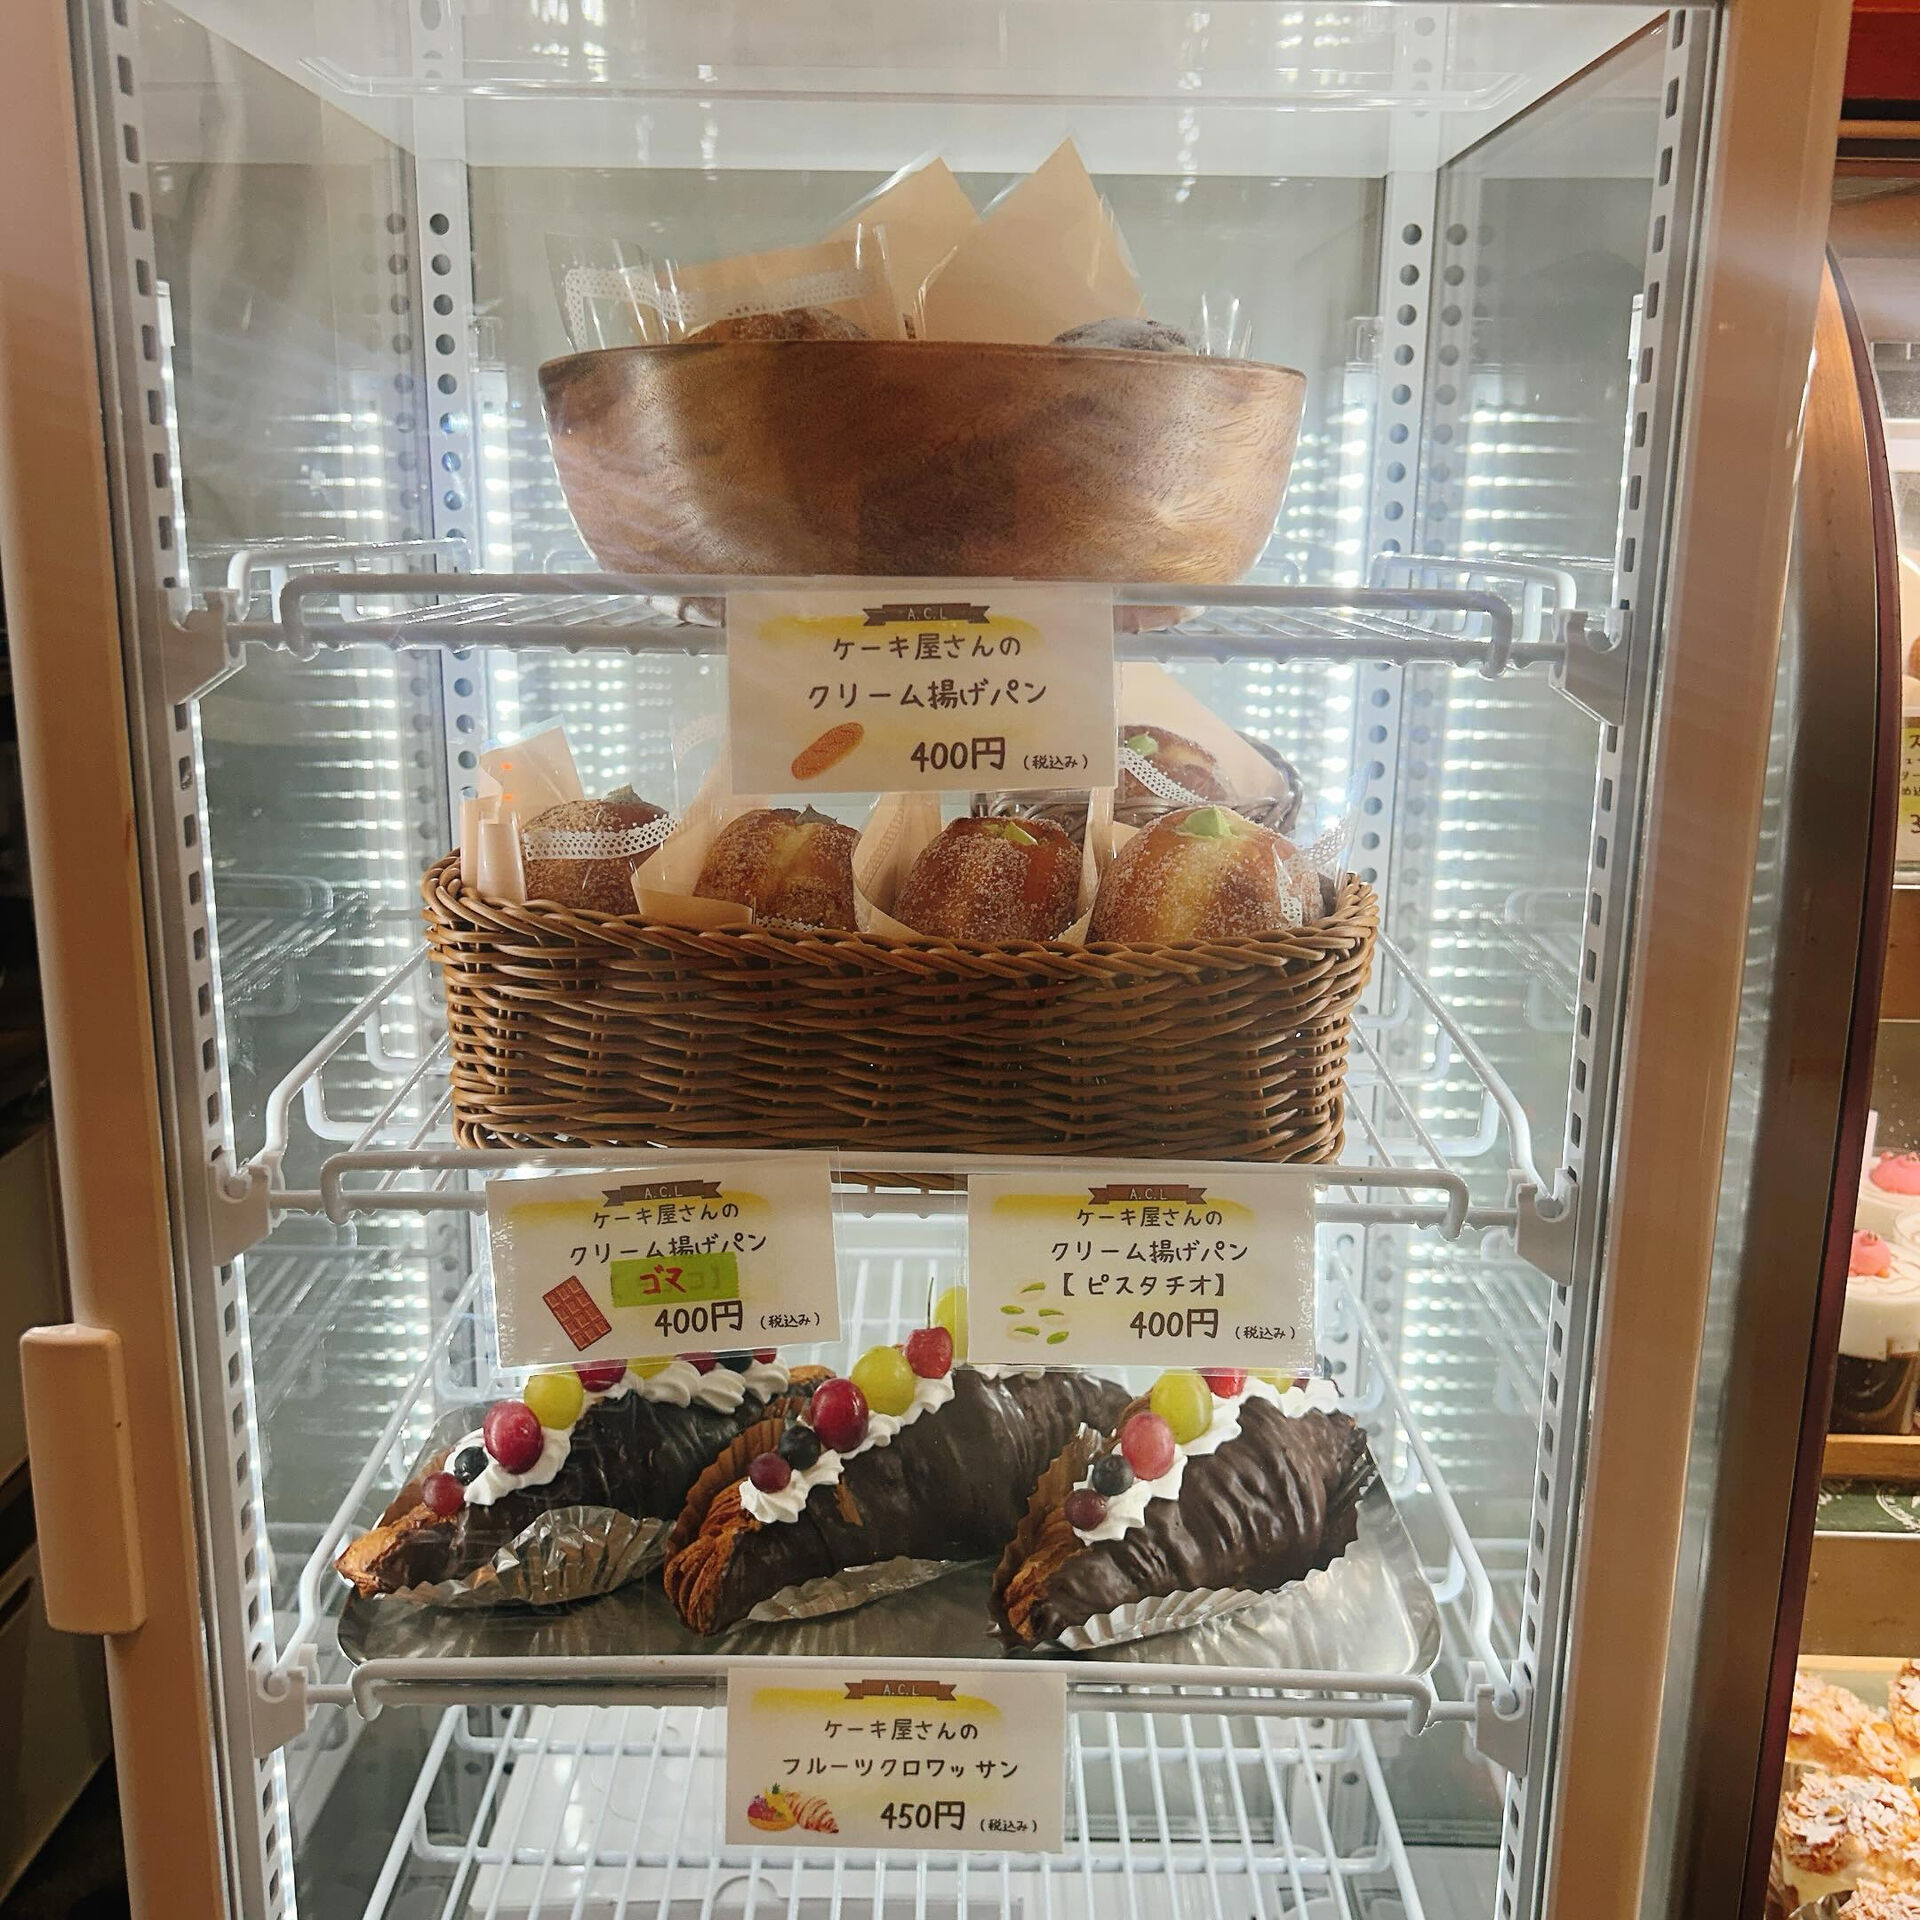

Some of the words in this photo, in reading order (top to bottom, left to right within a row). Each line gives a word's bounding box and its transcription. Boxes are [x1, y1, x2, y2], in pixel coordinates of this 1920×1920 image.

[833, 633, 1021, 660] ケーキ屋さんの
[808, 678, 1046, 710] クリーム揚げパン
[911, 737, 1005, 772] 400円
[1023, 754, 1088, 770] (税込み)
[593, 1203, 738, 1229] ケーキ屋さんの
[1077, 1207, 1222, 1227] ケーキ屋さんの
[570, 1232, 766, 1265] クリーム揚げパン
[1051, 1239, 1248, 1263] クリーム揚げパン
[640, 1264, 686, 1294] ゴマ
[655, 1300, 743, 1337] 400円
[760, 1312, 820, 1330] (税込み)
[1130, 1308, 1218, 1338] 400円
[1235, 1325, 1296, 1340] (税込み)
[824, 1718, 978, 1740] ケーキ屋さんの
[783, 1757, 1018, 1779] フルーツクロワッサン
[880, 1800, 965, 1830] 450円
[980, 1819, 1038, 1833] (税込み)
